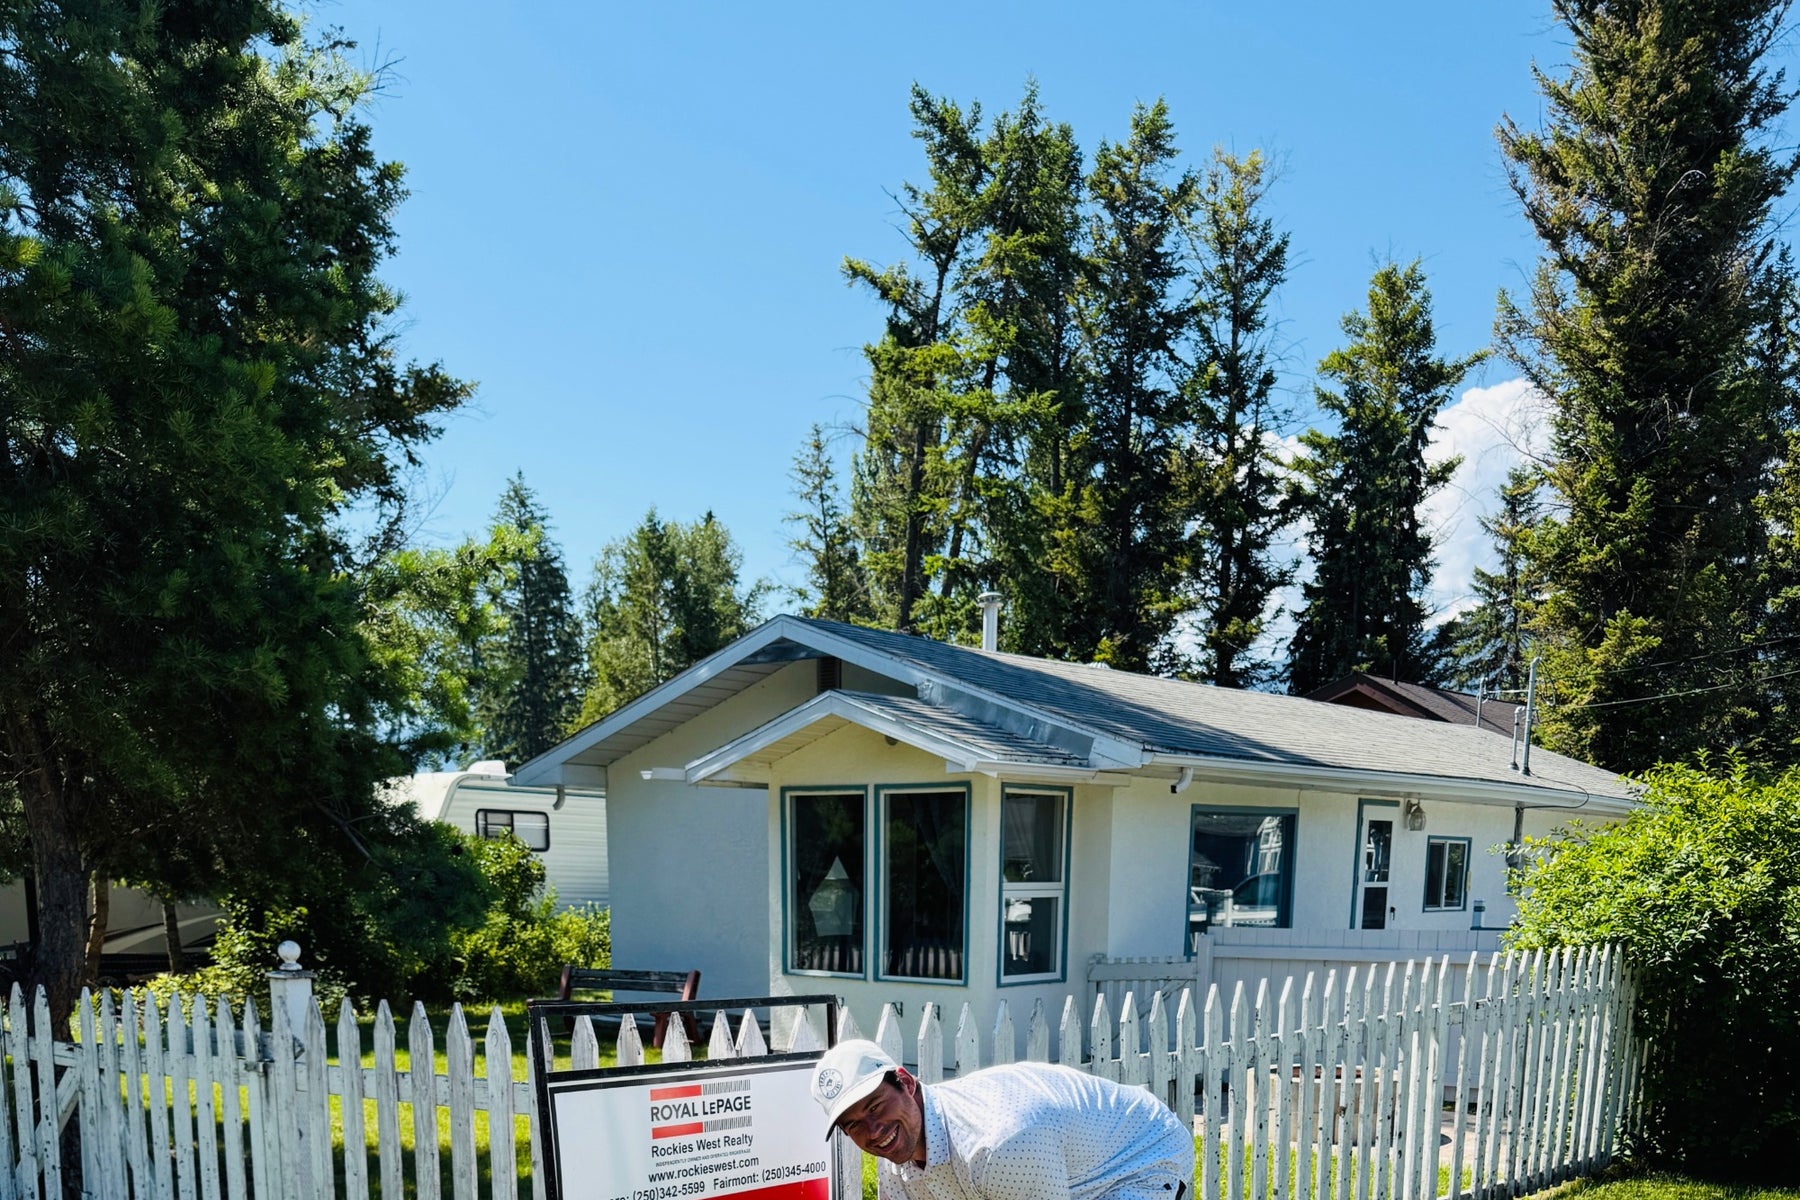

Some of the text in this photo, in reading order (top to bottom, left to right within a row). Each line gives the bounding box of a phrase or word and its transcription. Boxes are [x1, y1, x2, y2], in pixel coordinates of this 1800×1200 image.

[650, 1102, 698, 1122] ROYAL
[651, 1133, 753, 1158] Rockies West Realty
[648, 1157, 760, 1183] www.rockieswest.com
[713, 1173, 760, 1191] Fairmont:
[761, 1160, 827, 1183] (250)345-4000
